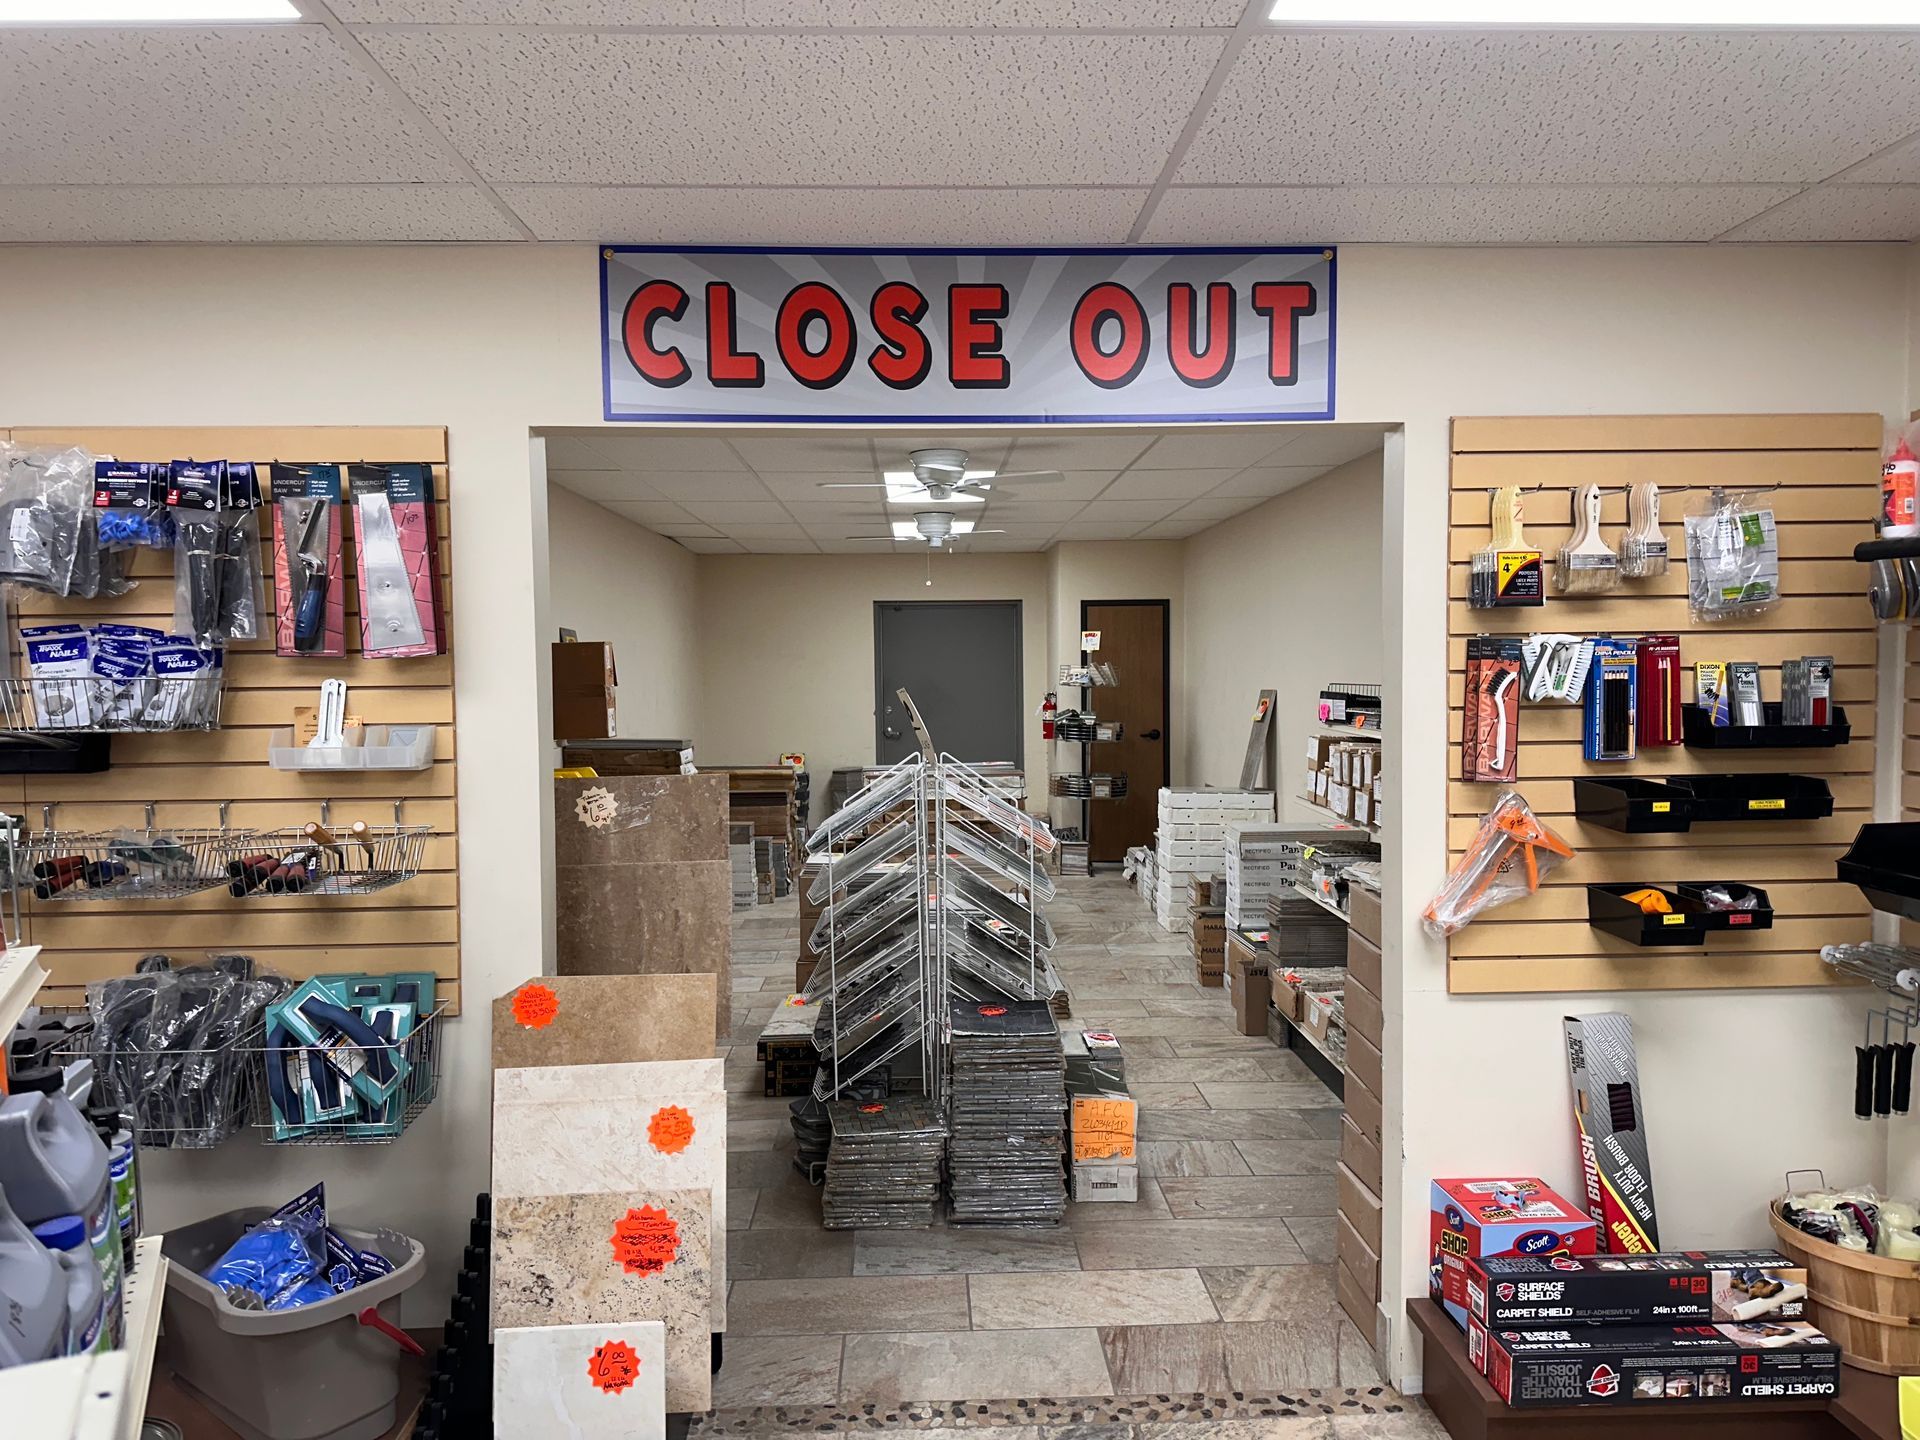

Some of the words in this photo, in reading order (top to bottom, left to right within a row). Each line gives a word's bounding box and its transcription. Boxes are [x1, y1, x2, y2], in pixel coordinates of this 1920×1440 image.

[621, 280, 1010, 390] CLOSE
[1070, 281, 1317, 390] OUT
[277, 511, 295, 648] BARWA
[38, 644, 64, 652] TRAXX
[50, 649, 79, 658] NAILS
[158, 654, 183, 663] TRAXX
[167, 660, 198, 668] NAILS
[1567, 1031, 1576, 1051] DUTY
[1595, 1031, 1628, 1076] PROFESSIONAL
[1607, 1035, 1629, 1062] QUALITY
[1569, 1052, 1578, 1074] HEAVY
[1603, 1134, 1628, 1166] BRUSH
[1580, 1133, 1602, 1202] BRUSH
[1612, 1171, 1638, 1195] DUTY
[1623, 1163, 1649, 1192] FLOOR
[1626, 1193, 1653, 1221] HEAVY
[1449, 1212, 1460, 1226] Scott
[1481, 1209, 1514, 1219] SHOP
[1441, 1229, 1469, 1257] SHOP
[1526, 1234, 1550, 1252] Scott
[1443, 1254, 1465, 1272] ORIGINAL
[1518, 1282, 1565, 1292] SURFACE
[1518, 1291, 1561, 1301] SHIELDS
[1496, 1308, 1537, 1318] CARPET
[1538, 1307, 1573, 1317] SHIELD
[1653, 1305, 1671, 1314] 24in
[1678, 1305, 1698, 1313] 100ft
[1528, 1365, 1582, 1376] JOBSITE.
[1522, 1377, 1547, 1388] THE
[1550, 1375, 1582, 1387] THAN
[1775, 1375, 1834, 1383] SELF-ADHESIVE
[1522, 1387, 1582, 1399] TOUGHER
[1742, 1384, 1785, 1396] SHIELD
[1786, 1382, 1835, 1395] CARPET
